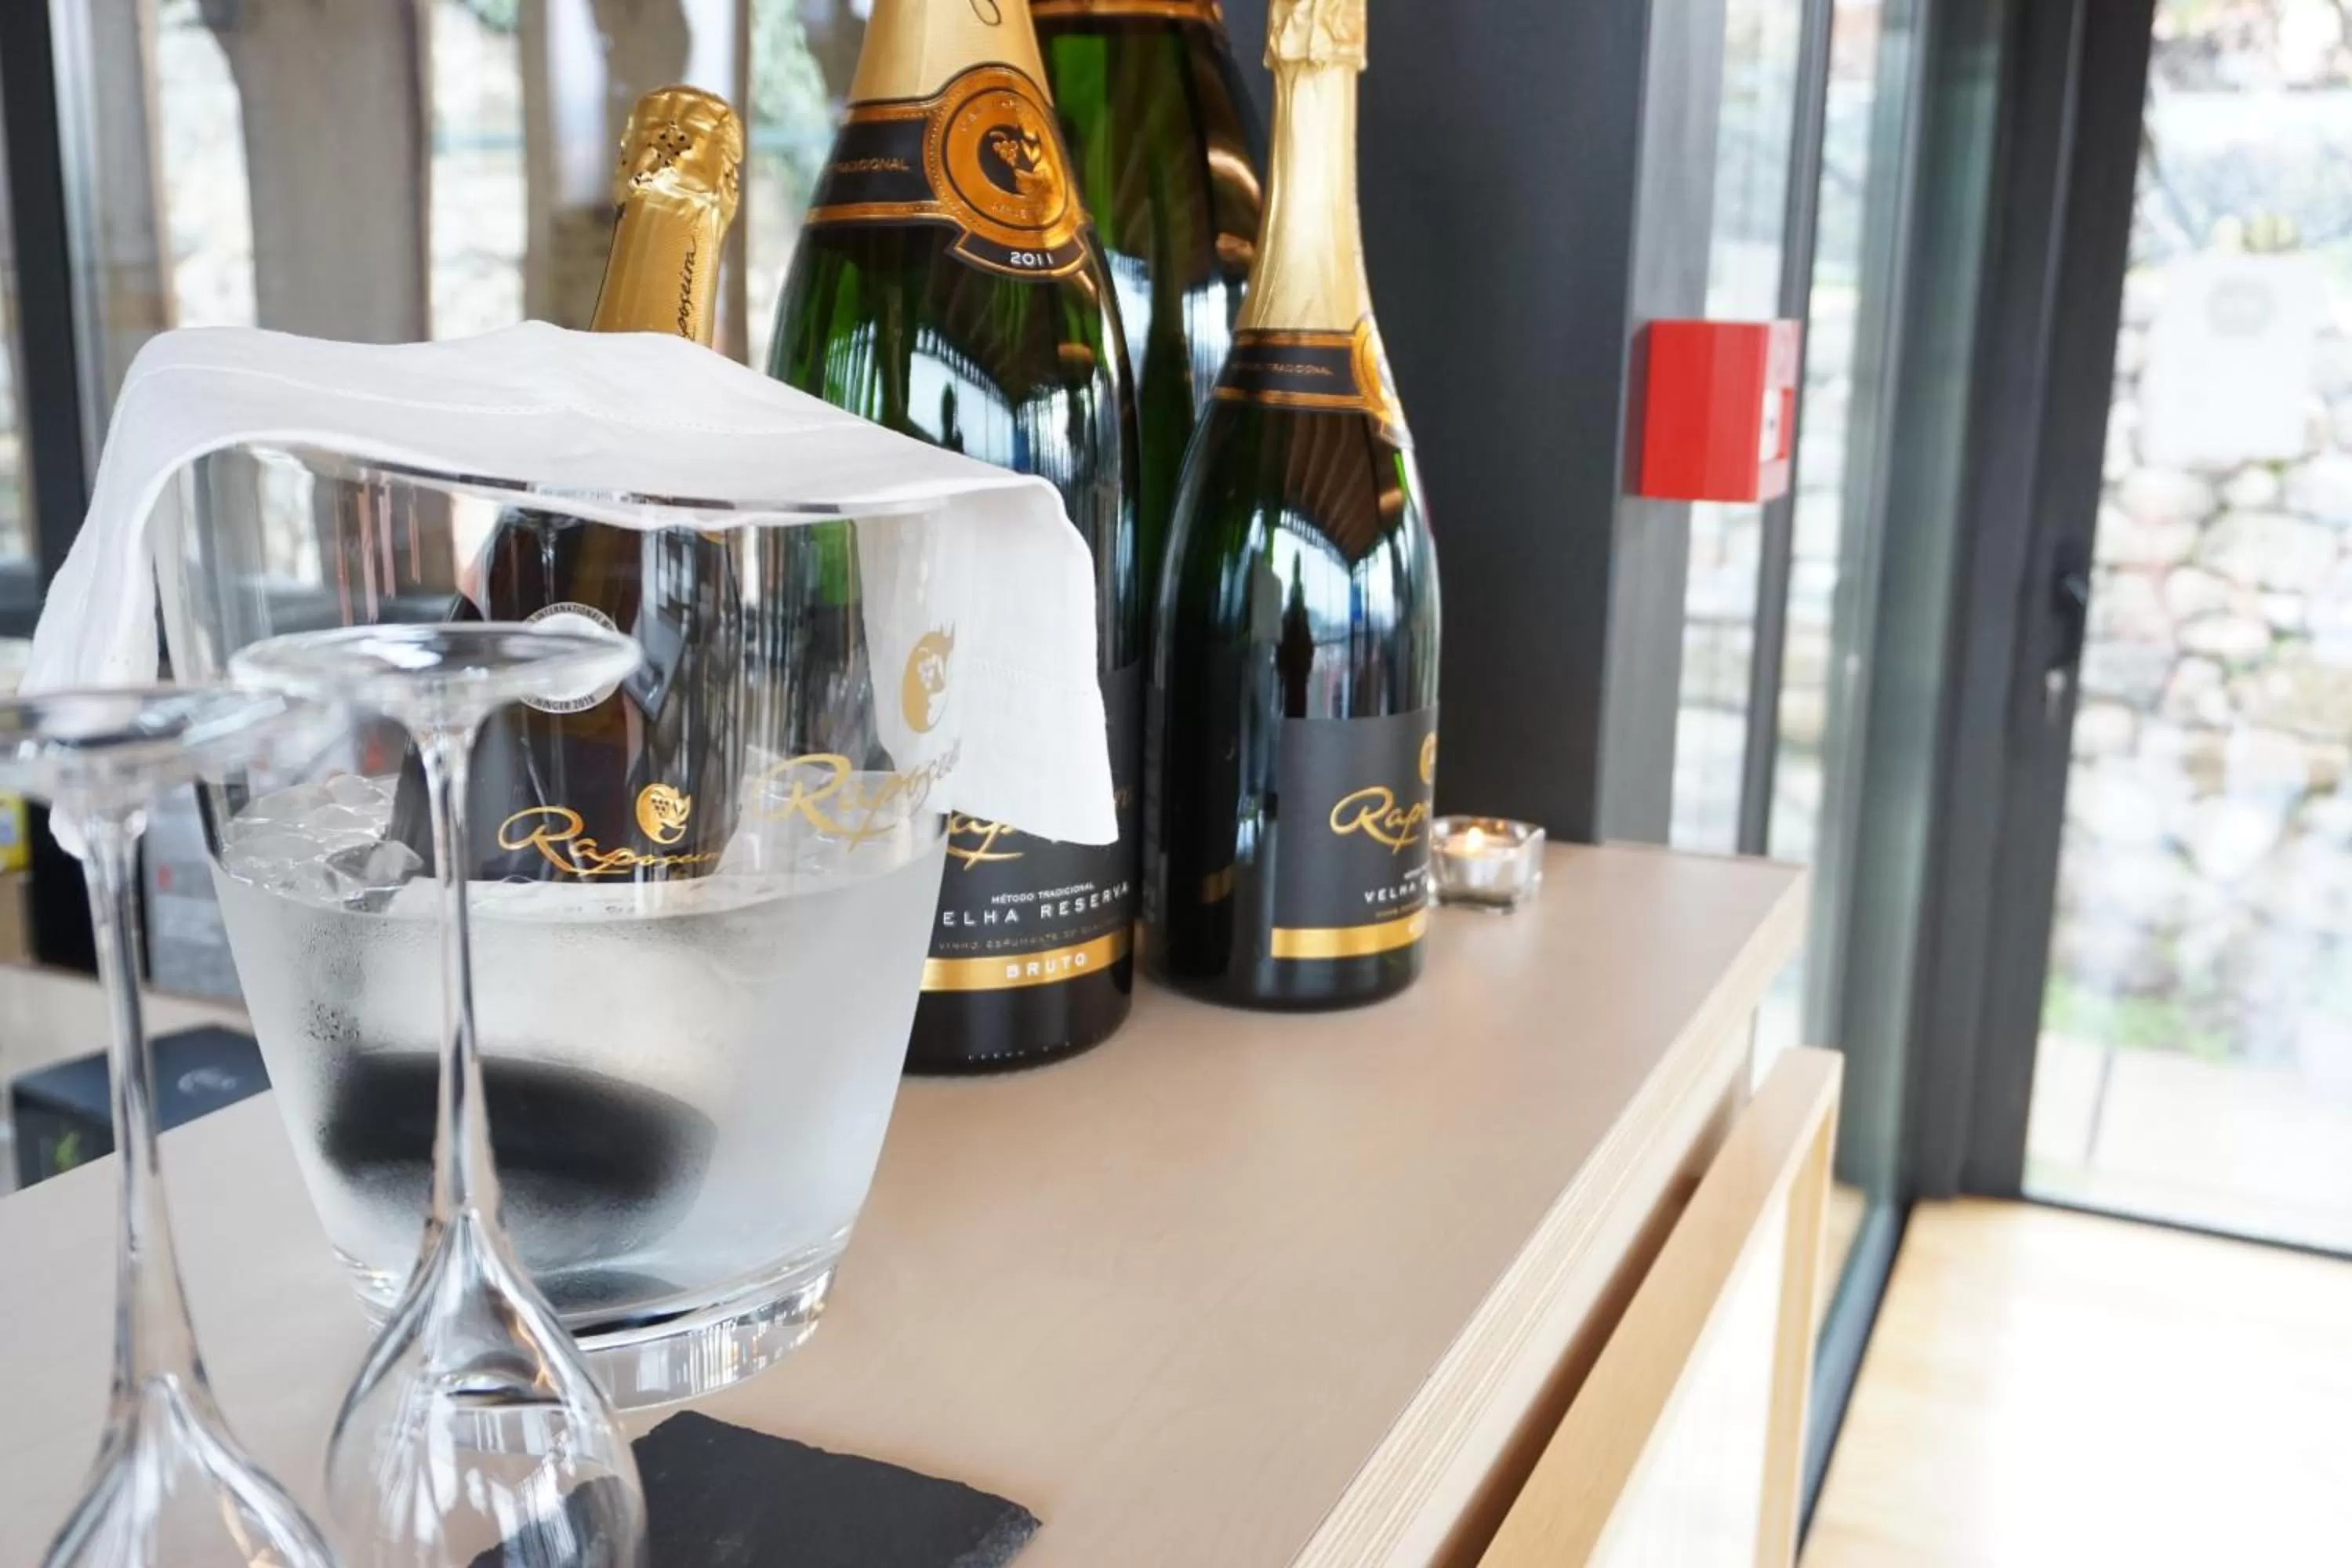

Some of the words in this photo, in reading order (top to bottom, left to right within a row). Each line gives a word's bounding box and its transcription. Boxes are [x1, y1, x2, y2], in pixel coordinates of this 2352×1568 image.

[1010, 251, 1054, 267] 2011
[673, 234, 697, 342] poseira
[943, 908, 1019, 926] ELHA
[1040, 881, 1129, 920] RESERVA
[991, 891, 1035, 904] MÉTODO
[1037, 881, 1095, 899] TRADICIONAL
[1006, 953, 1087, 978] BRUTO
